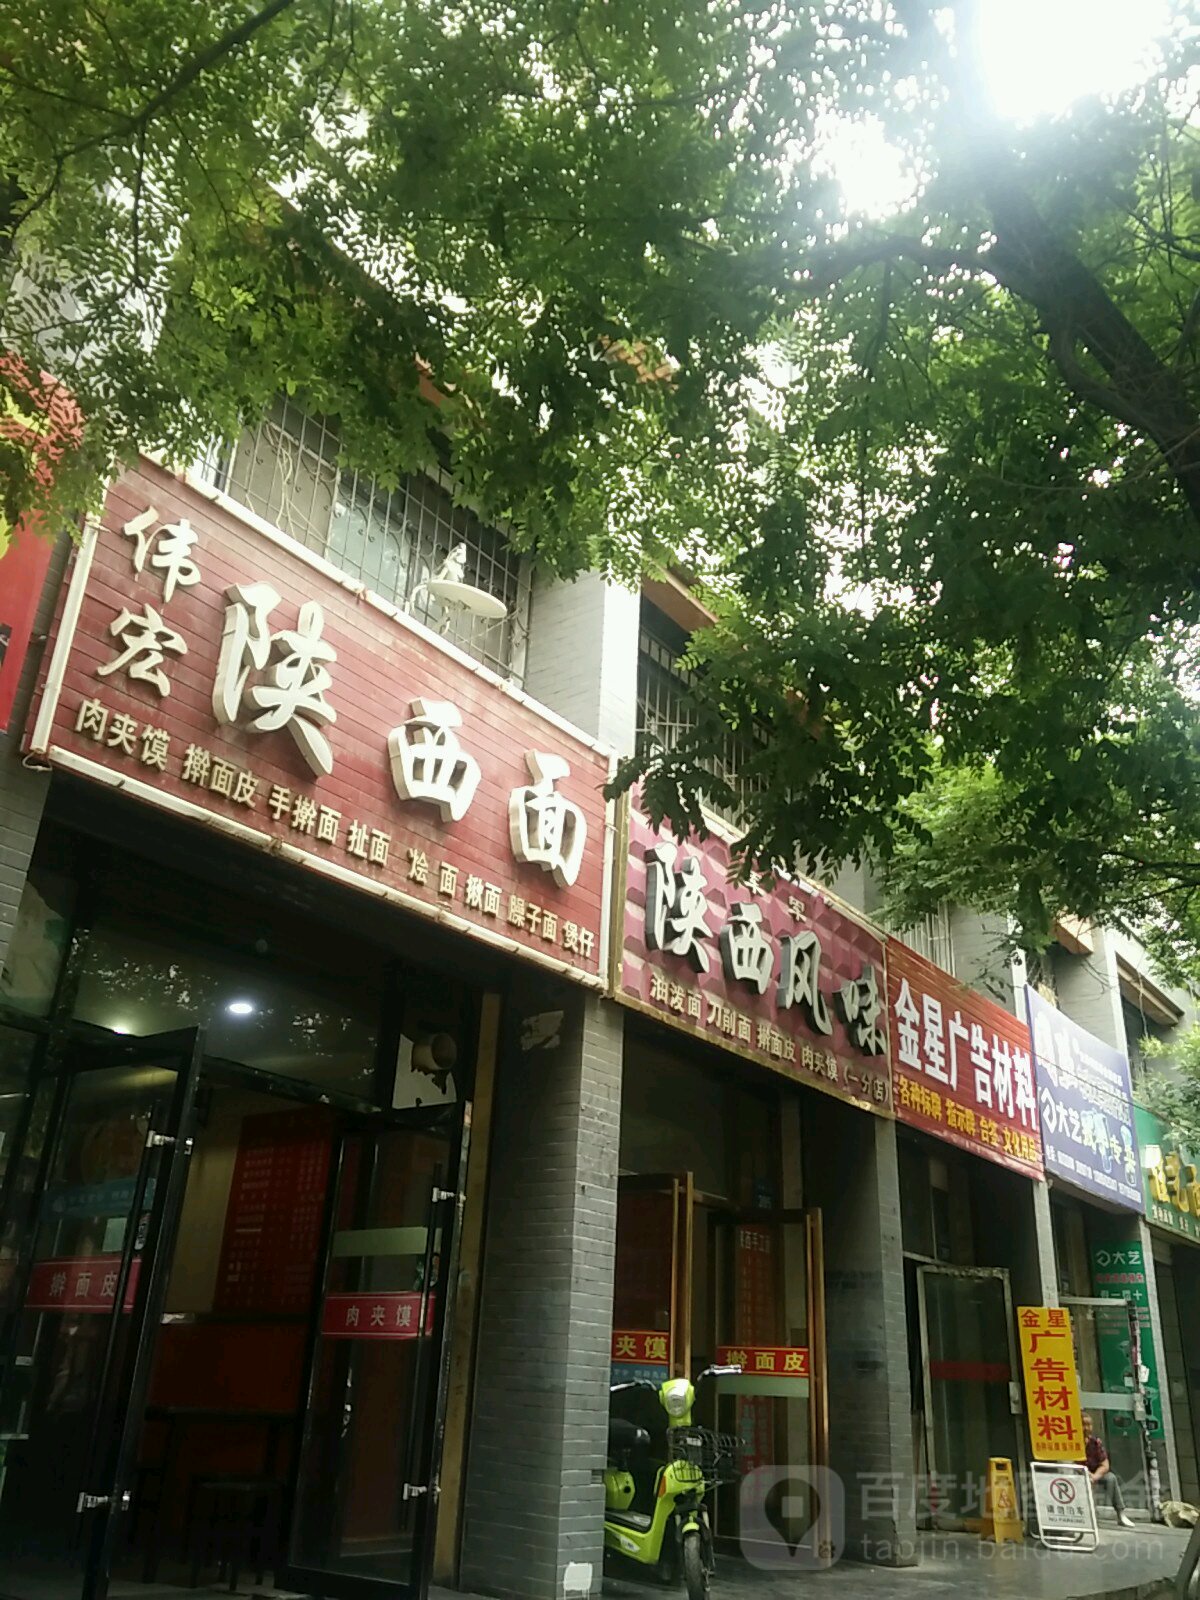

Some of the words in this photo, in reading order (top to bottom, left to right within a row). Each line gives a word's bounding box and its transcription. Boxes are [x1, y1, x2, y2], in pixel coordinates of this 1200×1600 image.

[98, 505, 201, 697] 伟宏
[212, 580, 588, 888] 陕西面
[75, 699, 171, 771] 肉夹馍
[182, 744, 259, 807] 擀面皮
[269, 784, 342, 844] 手擀面
[347, 819, 391, 867] 扯面
[406, 848, 459, 897] 烩面
[507, 895, 559, 943] 臊子面
[561, 921, 595, 958] 煲仔
[644, 841, 887, 1056] 陕西风味
[650, 974, 703, 1020] 油泼面
[706, 1001, 753, 1043] 刀削面
[801, 1046, 839, 1083] 肉夹馍
[894, 977, 1038, 1132] 金星广告材料
[1002, 1126, 1038, 1163] 文化用品
[49, 1271, 117, 1298] 擀面皮
[1112, 1250, 1142, 1265] 大艺
[346, 1304, 413, 1327] 肉夹馍
[615, 1334, 669, 1360] 夹馍
[1020, 1308, 1069, 1329] 金星
[726, 1350, 806, 1372] 擀面皮
[1028, 1330, 1078, 1441] 广告材料
